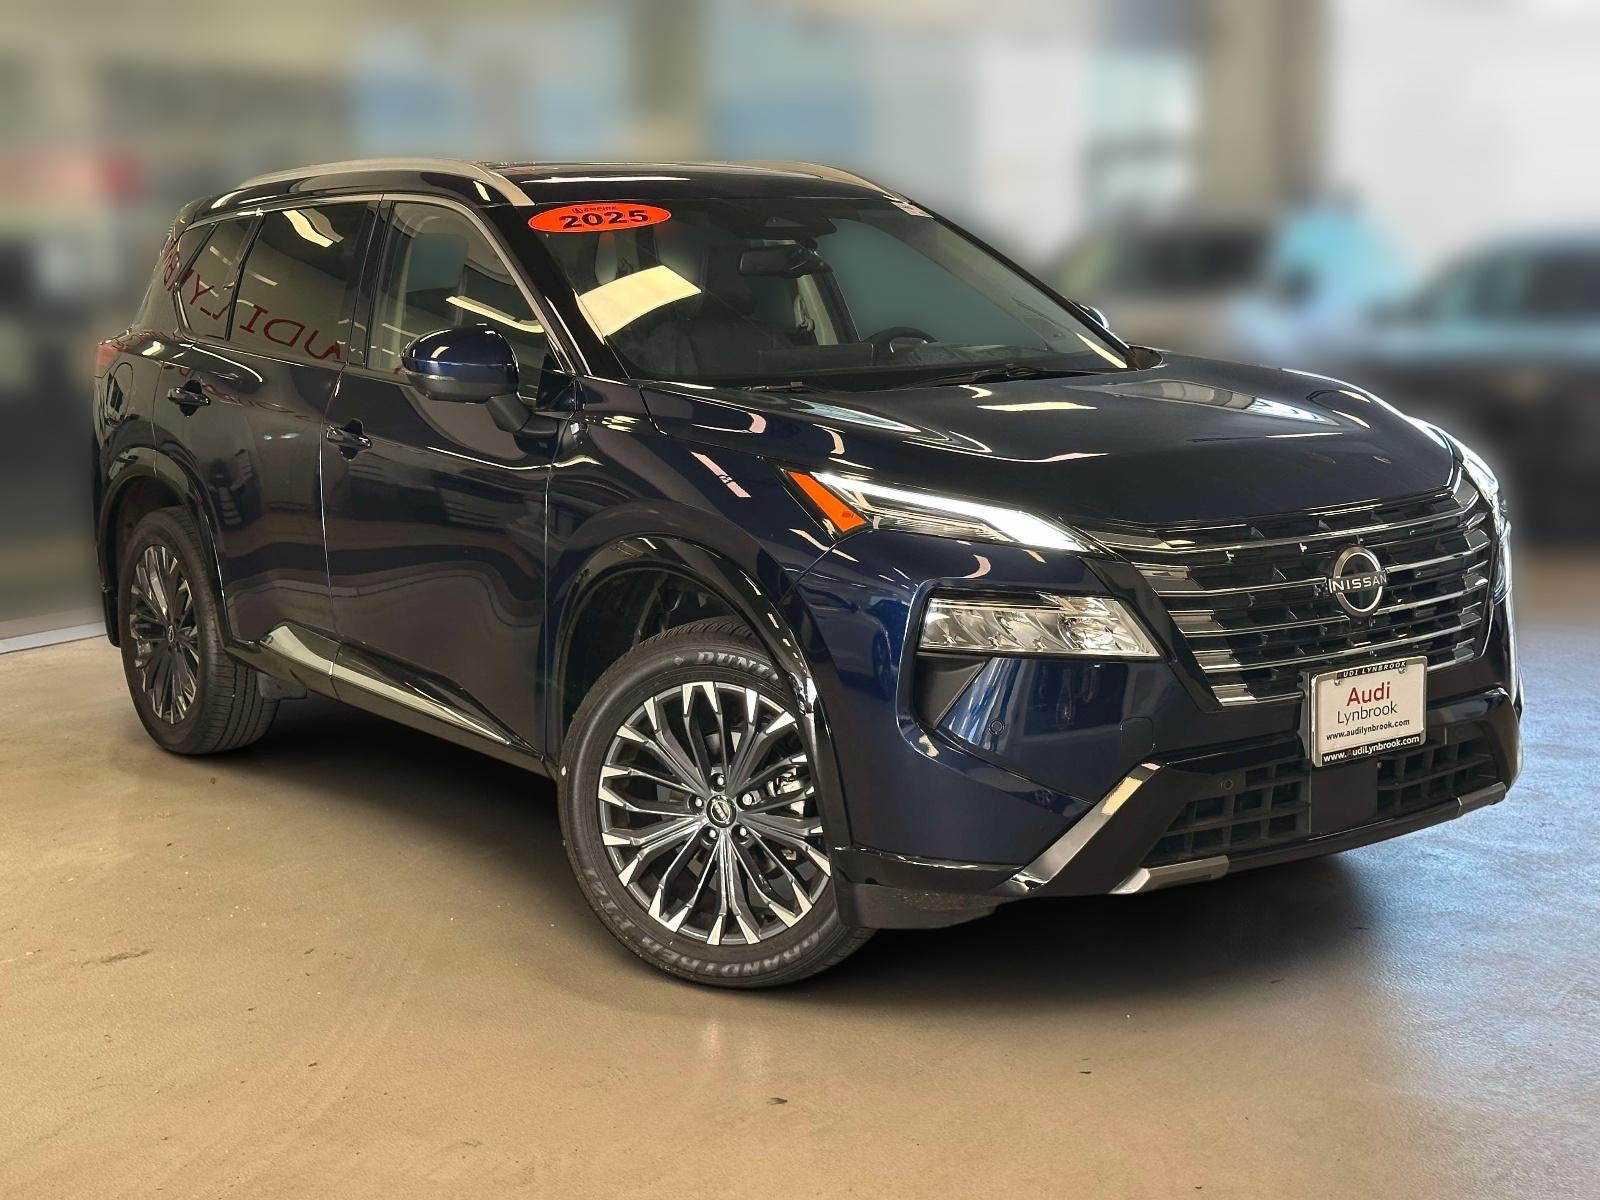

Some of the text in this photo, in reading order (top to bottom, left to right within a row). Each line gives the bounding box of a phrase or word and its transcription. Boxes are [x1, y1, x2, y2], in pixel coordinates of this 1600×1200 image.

[559, 209, 649, 229] 2025
[1332, 574, 1387, 591] NISSAN
[1361, 661, 1407, 674] LYNBROOK
[1346, 681, 1391, 706] Audi
[1337, 701, 1398, 726] Lynbrook
[1326, 719, 1410, 740] www.audilynbrook.com
[1323, 735, 1420, 762] www.AudiLynbrook.com
